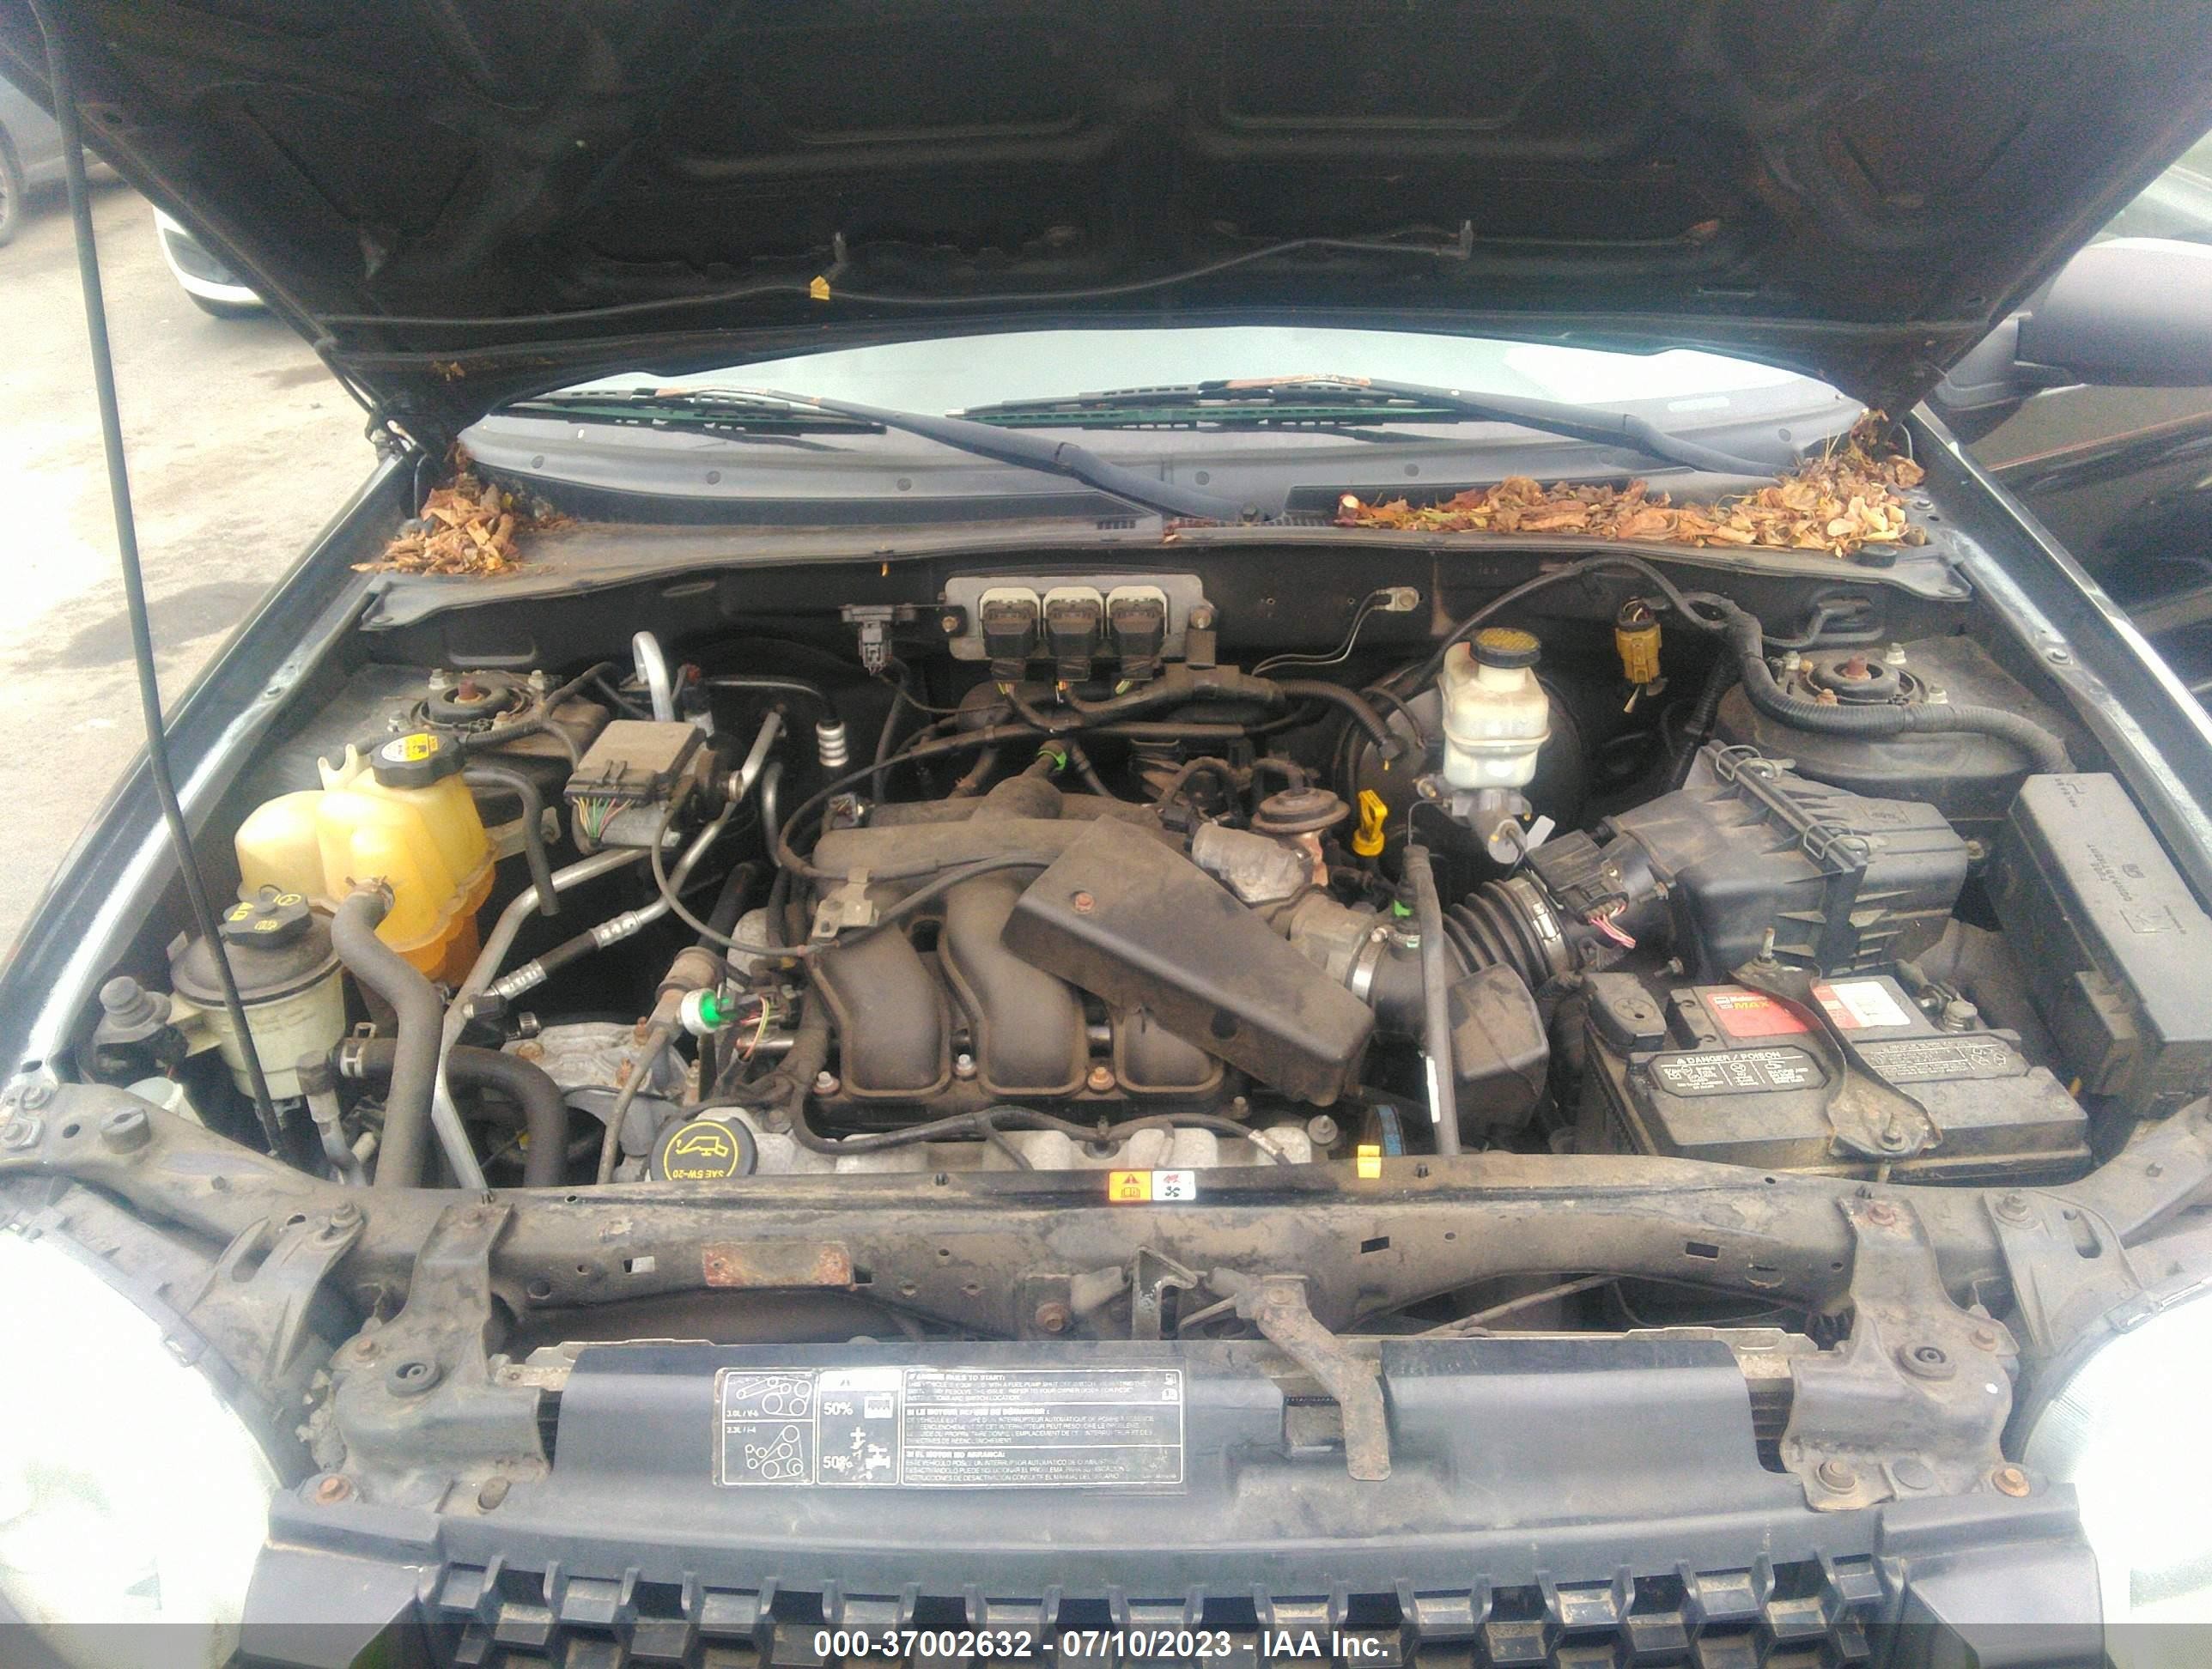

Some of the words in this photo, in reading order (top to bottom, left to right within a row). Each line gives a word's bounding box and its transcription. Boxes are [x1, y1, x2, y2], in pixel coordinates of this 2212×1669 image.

[1686, 1054, 1731, 1065] DANGER
[1741, 1052, 1781, 1061] POISON
[672, 1169, 703, 1179] 5W-20
[705, 1169, 725, 1179] SAE
[823, 1401, 854, 1416] 50%
[823, 1455, 854, 1469] 50%
